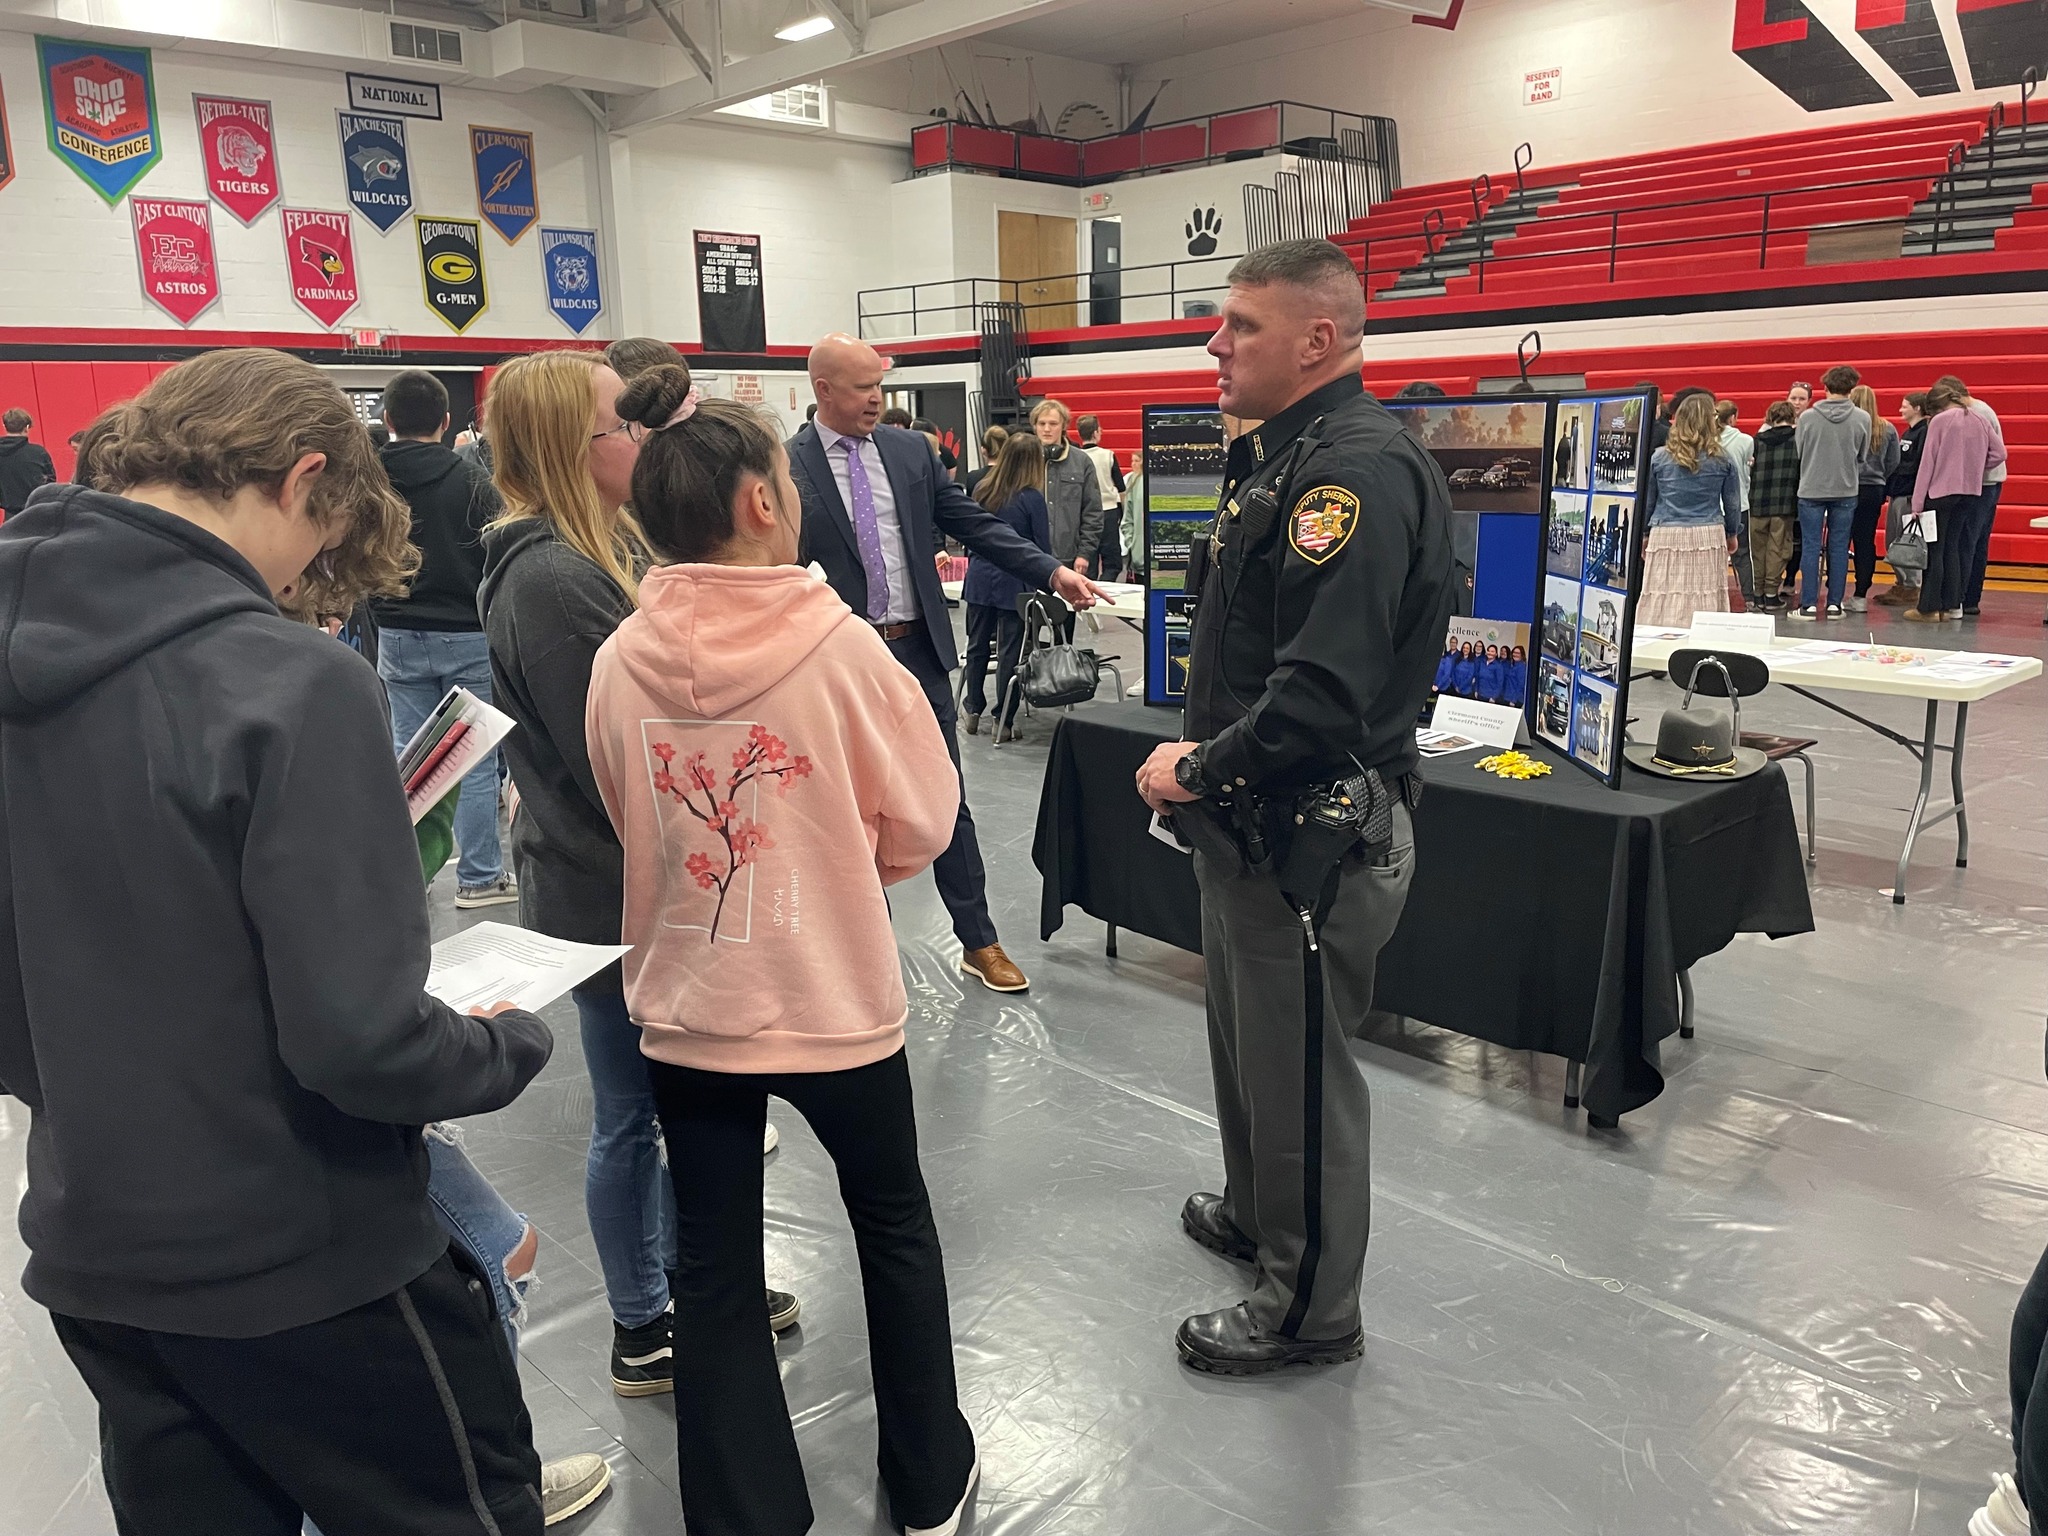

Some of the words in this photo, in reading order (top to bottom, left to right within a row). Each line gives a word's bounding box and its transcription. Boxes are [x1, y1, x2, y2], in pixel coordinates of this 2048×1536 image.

[1526, 69, 1560, 82] RESERVED
[1534, 81, 1550, 91] FOR
[73, 76, 125, 103] OHIO
[361, 86, 428, 107] NATIONAL
[1531, 91, 1552, 102] BAND
[76, 96, 126, 127] SBAAC
[199, 100, 269, 132] BETHEL-TATE
[65, 116, 101, 137] ACADEMIC
[110, 122, 140, 136] ATHLETIC
[340, 116, 404, 147] BLANCHESTER
[60, 131, 149, 162] CONFERENCE
[475, 132, 529, 160] CLERMONT
[217, 180, 269, 195] TIGERS
[352, 190, 408, 206] WILDCATS
[135, 203, 162, 230] EAST
[164, 203, 208, 233] CLINTON
[286, 211, 347, 237] FELICITY
[150, 234, 195, 261] EC
[421, 222, 477, 250] GEORGETOWN
[542, 232, 595, 257] WILLIAMSBURG
[430, 254, 474, 283] G
[156, 281, 207, 295] ASTROS
[297, 287, 355, 301] CARDINALS
[436, 292, 477, 305] G-MEN
[552, 297, 598, 309] WILDCATS
[1293, 492, 1320, 518] DEPUTY
[1322, 490, 1356, 507] SHERIFF
[790, 868, 800, 908] CHERRY
[773, 887, 784, 927] さくら
[790, 911, 800, 935] TREE
